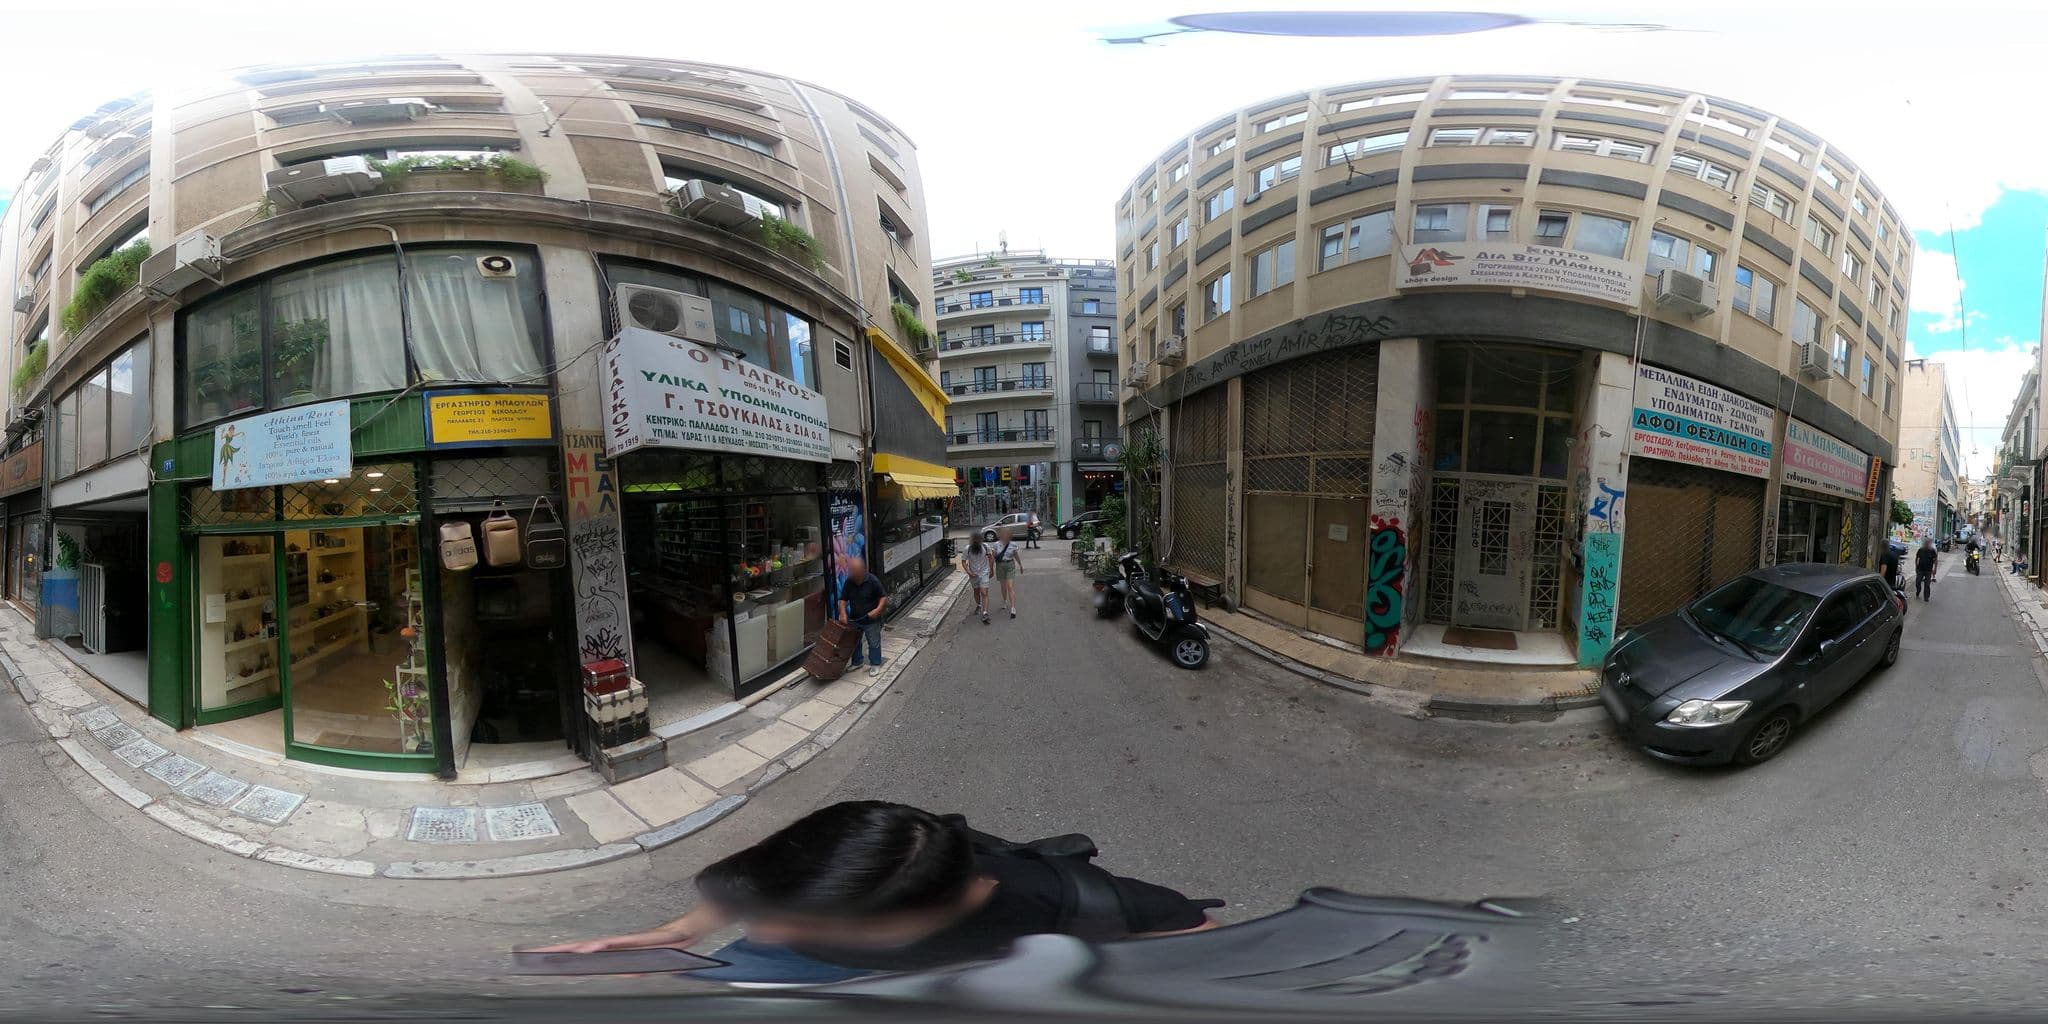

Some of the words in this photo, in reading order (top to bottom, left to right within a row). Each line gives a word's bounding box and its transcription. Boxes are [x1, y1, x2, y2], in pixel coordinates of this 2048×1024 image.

[1430, 274, 1458, 283] design
[640, 369, 709, 394] ΥΛΙΚΑ
[1639, 367, 1695, 392] ΜΕΤΑΛΛΙΚΑ
[1698, 383, 1719, 399] ΕΙΔΗ
[767, 388, 781, 399] 1919
[435, 399, 491, 409] ΕΡΓΑΣΤΗΡΙΟ
[495, 399, 544, 407] ΜΠΑΟΥΛΩΝ
[1664, 386, 1726, 413] ΕΝΔΥΜΑΤΩΝ
[1730, 407, 1758, 424] ΖΩΝΩΝ
[264, 414, 304, 428] Athina
[305, 409, 334, 421] Rose
[665, 392, 684, 411] Γ.
[694, 398, 783, 431] ΤΣΟΥΚΑΛΑΣ
[785, 423, 792, 434] &
[793, 423, 810, 439] ΣΙΑ
[1651, 397, 1723, 425] ΥΠΟΔΗΜΑΤΩΝ
[1729, 419, 1765, 438] ΤΣΑΝΤΩΝ
[269, 423, 291, 435] Touch
[292, 420, 312, 431] smell
[314, 419, 332, 428] Feel
[646, 414, 687, 428] ΚΕΝΤΡΙΚΟ:
[689, 419, 730, 434] ΠΑΛΛΑΔΟΣ
[730, 426, 738, 435] 21
[624, 435, 640, 447] 1919
[681, 431, 702, 442] ΥΔΡΑΣ
[704, 434, 710, 443] 11
[1634, 431, 1674, 448] ΕΡΓΟΣΤΑΣΙΟ:
[1636, 412, 1681, 434] ΑΦΟΙ
[1686, 423, 1747, 450] ΦΕΣΛΙΔΗ
[1750, 441, 1770, 456] Ο.Ε.
[273, 438, 306, 449] Essential
[308, 436, 322, 445] oils
[285, 447, 300, 457] pure
[301, 445, 308, 453] &
[310, 442, 334, 452] natural
[1643, 445, 1676, 459] ΠΡΑΤΗΡΙΟ:
[300, 468, 306, 476] &
[445, 546, 475, 557] adas
